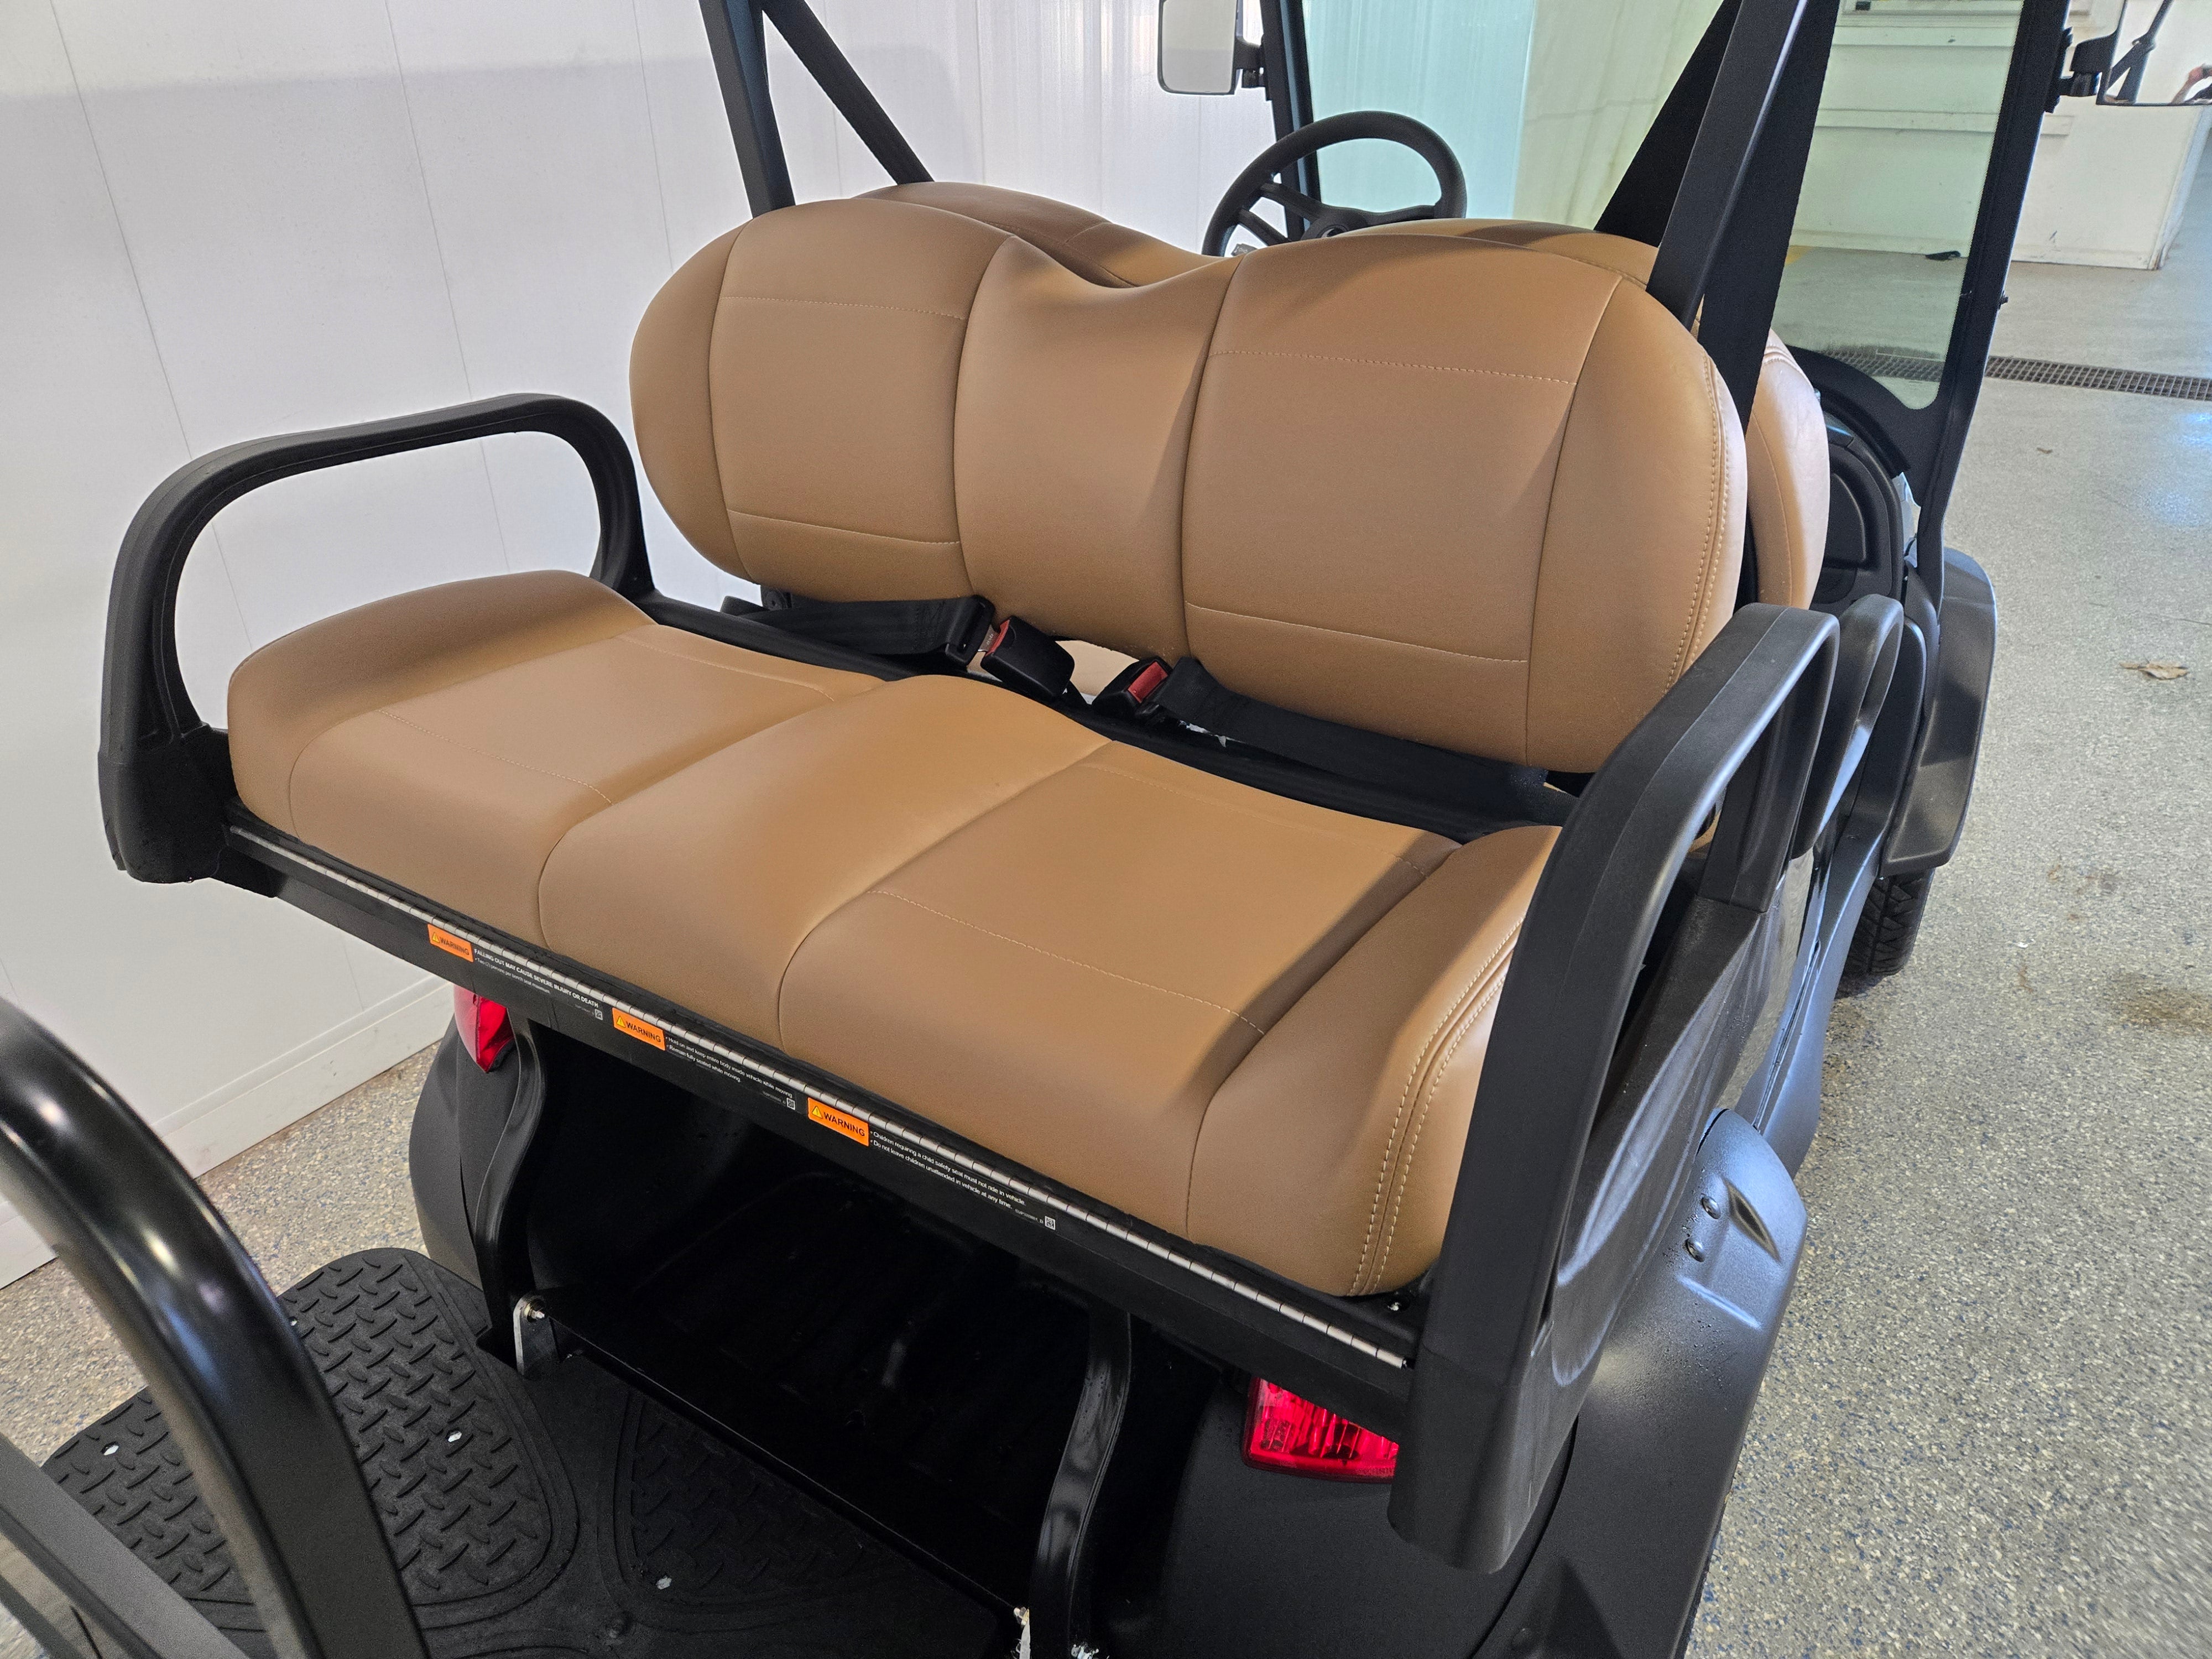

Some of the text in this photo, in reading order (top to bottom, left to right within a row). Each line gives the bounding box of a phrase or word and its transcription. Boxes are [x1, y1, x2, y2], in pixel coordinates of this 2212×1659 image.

[440, 937, 469, 955] WARNING
[474, 948, 494, 961] FALLING
[494, 957, 504, 966] OUT
[505, 962, 515, 970] MAY
[517, 967, 533, 978] CAUSE
[534, 975, 553, 988] SEVERE
[554, 984, 571, 995] INJURY
[581, 997, 598, 1008] DEATH
[626, 1021, 661, 1042] WARNING
[670, 1045, 686, 1056] Remain
[687, 1052, 696, 1061] fully
[696, 1057, 711, 1067] seated
[695, 1048, 706, 1058] keep
[720, 1060, 731, 1070] body
[746, 1073, 762, 1083] vehicle
[763, 1081, 774, 1089] while
[824, 1112, 865, 1136] WARNING
[874, 1131, 894, 1145] Children
[895, 1143, 916, 1156] requiring
[922, 1154, 934, 1163] child
[935, 1161, 951, 1172] safety
[952, 1168, 963, 1177] seat
[964, 1175, 977, 1183] must
[1006, 1193, 1026, 1205] vehicle.
[891, 1148, 904, 1158] leave
[905, 1155, 925, 1168] children
[926, 1166, 954, 1182] unattended
[962, 1182, 980, 1194] vehicle
[988, 1194, 998, 1204] any
[999, 1199, 1012, 1208] time.
